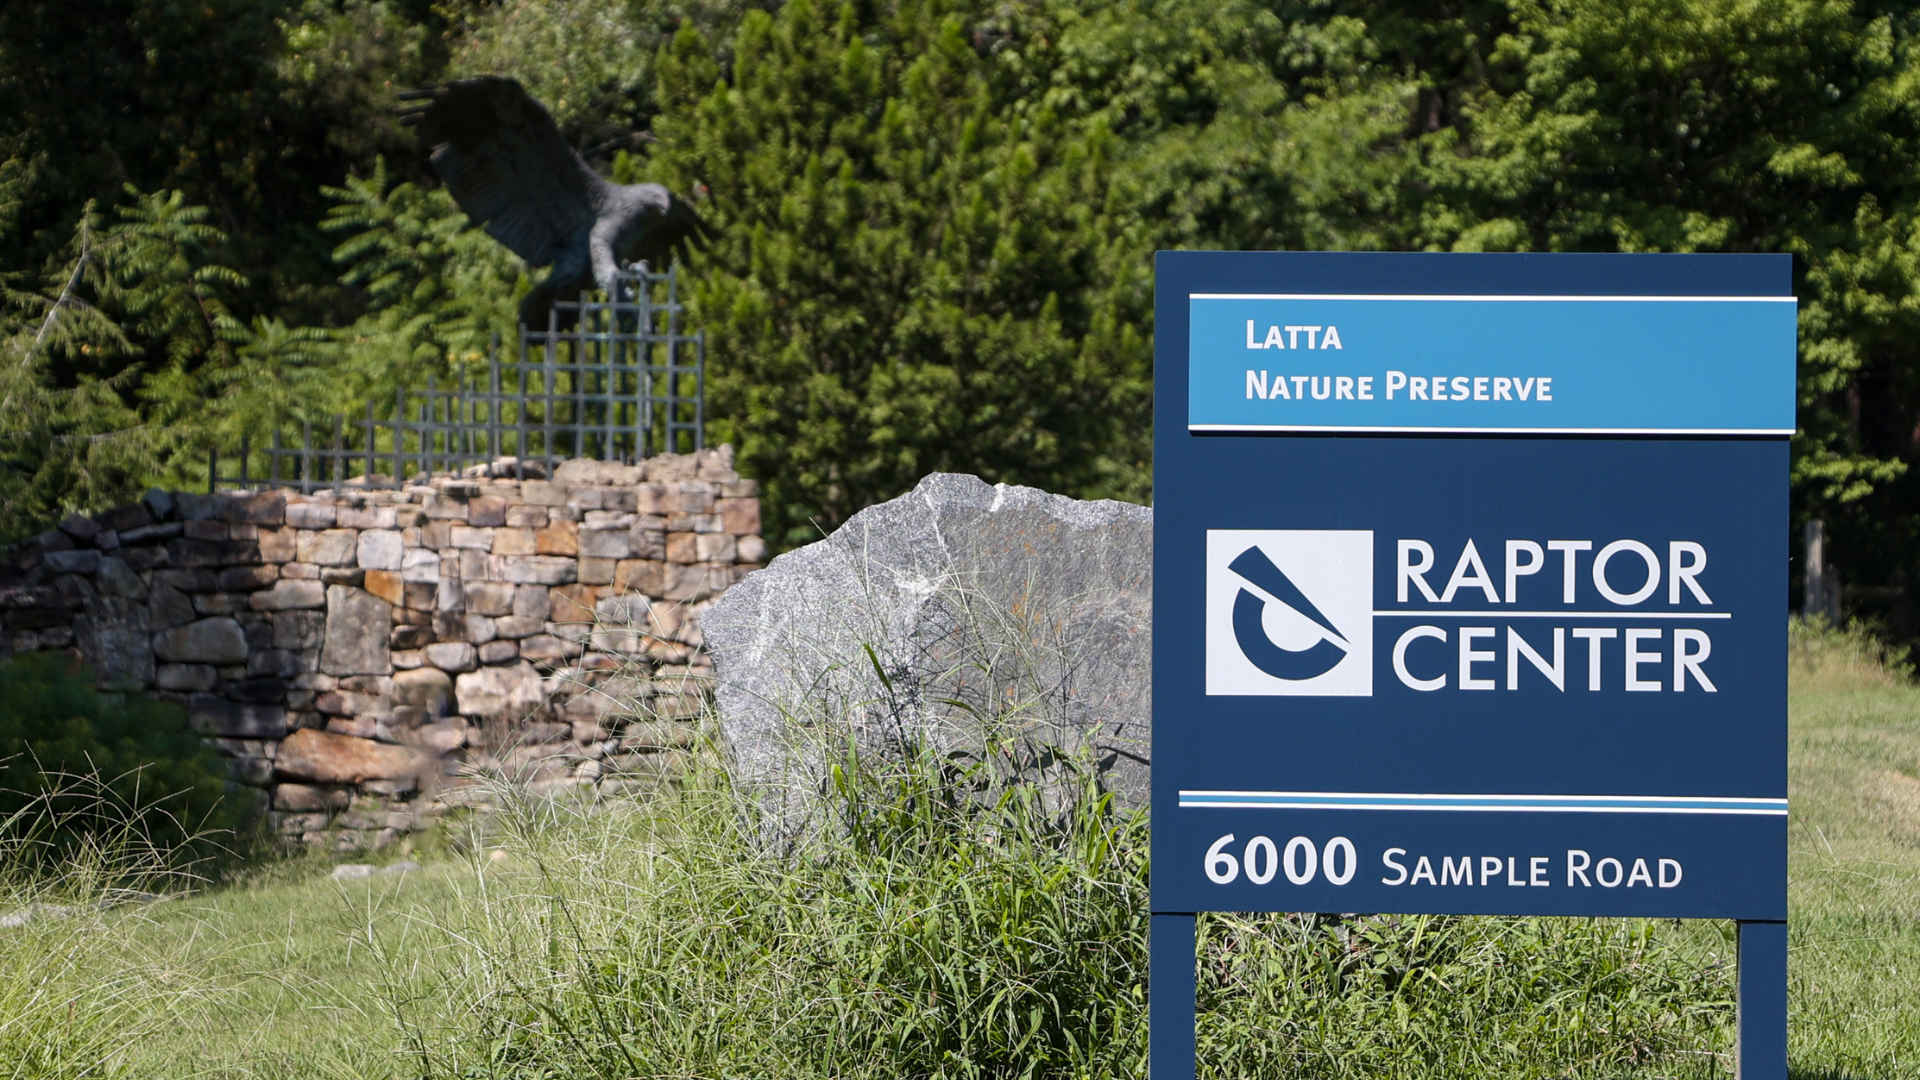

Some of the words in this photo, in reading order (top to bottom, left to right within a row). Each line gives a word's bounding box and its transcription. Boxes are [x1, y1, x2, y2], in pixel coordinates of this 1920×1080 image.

[1246, 319, 1343, 350] LATTA
[1245, 369, 1374, 402] NATURE
[1385, 370, 1553, 403] PRESERVE
[1397, 537, 1713, 606] RAPTOR
[1392, 625, 1718, 693] CENTER
[1204, 833, 1358, 886] 6000
[1381, 847, 1550, 887] SAMPLE
[1567, 849, 1684, 889] ROAD
